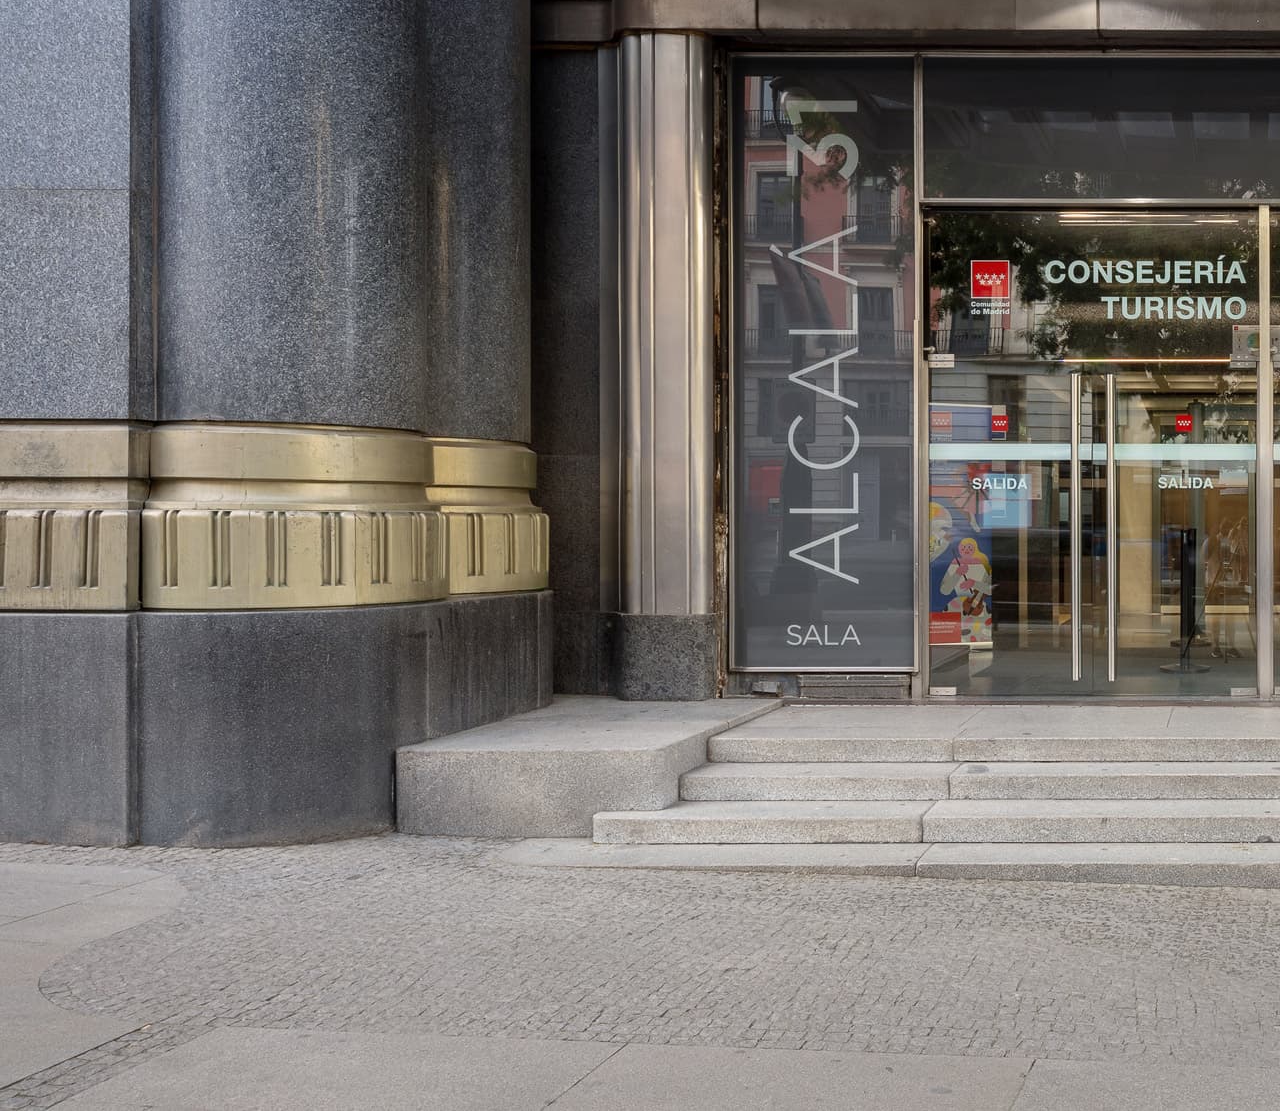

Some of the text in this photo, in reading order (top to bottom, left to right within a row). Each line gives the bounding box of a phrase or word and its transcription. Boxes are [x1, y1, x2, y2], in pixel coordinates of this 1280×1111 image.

[1045, 254, 1247, 284] CONSEJERÍA
[970, 300, 1010, 308] Comunidad
[1101, 296, 1247, 320] TURISMO
[769, 100, 859, 585] ALCALÁ 31
[972, 477, 1028, 490] SALIDA
[1158, 477, 1214, 489] SALIDA
[786, 624, 861, 646] SALA
